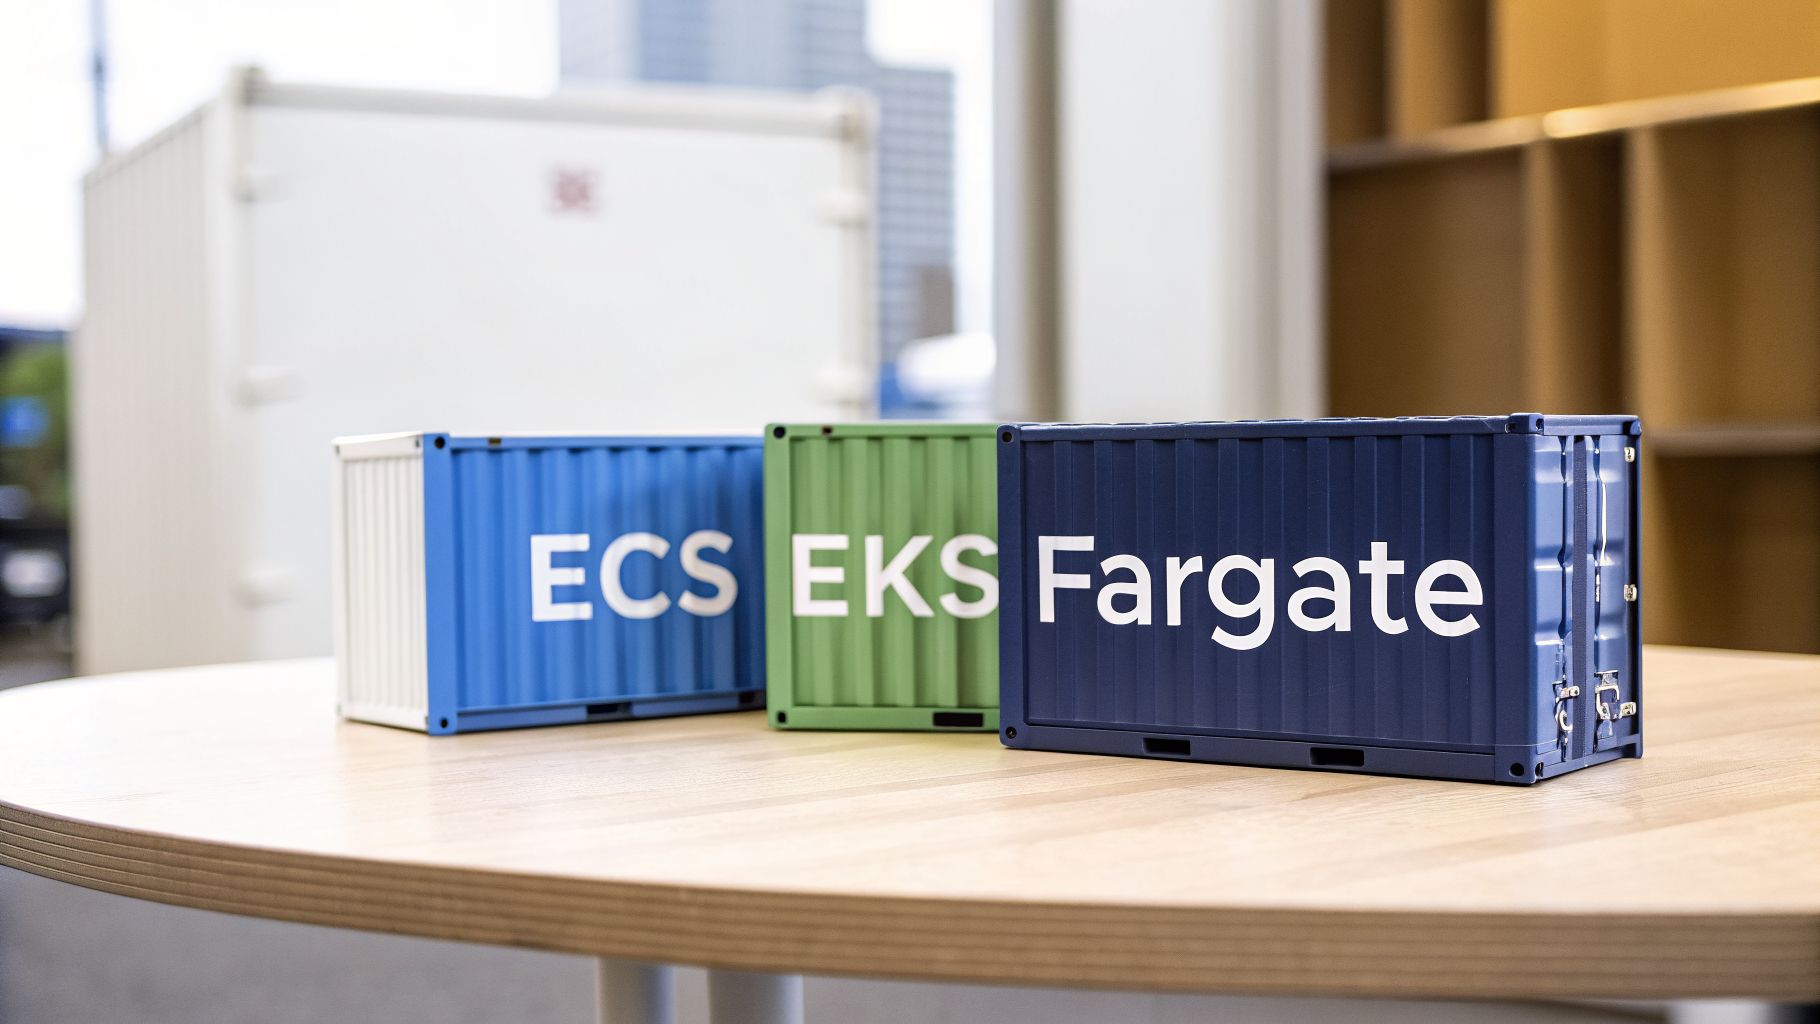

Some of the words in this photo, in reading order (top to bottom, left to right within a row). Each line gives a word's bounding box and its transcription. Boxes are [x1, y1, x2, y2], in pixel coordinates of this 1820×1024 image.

[530, 530, 738, 622] ECS
[792, 533, 999, 619] EKS
[1038, 535, 1484, 651] Fargate
